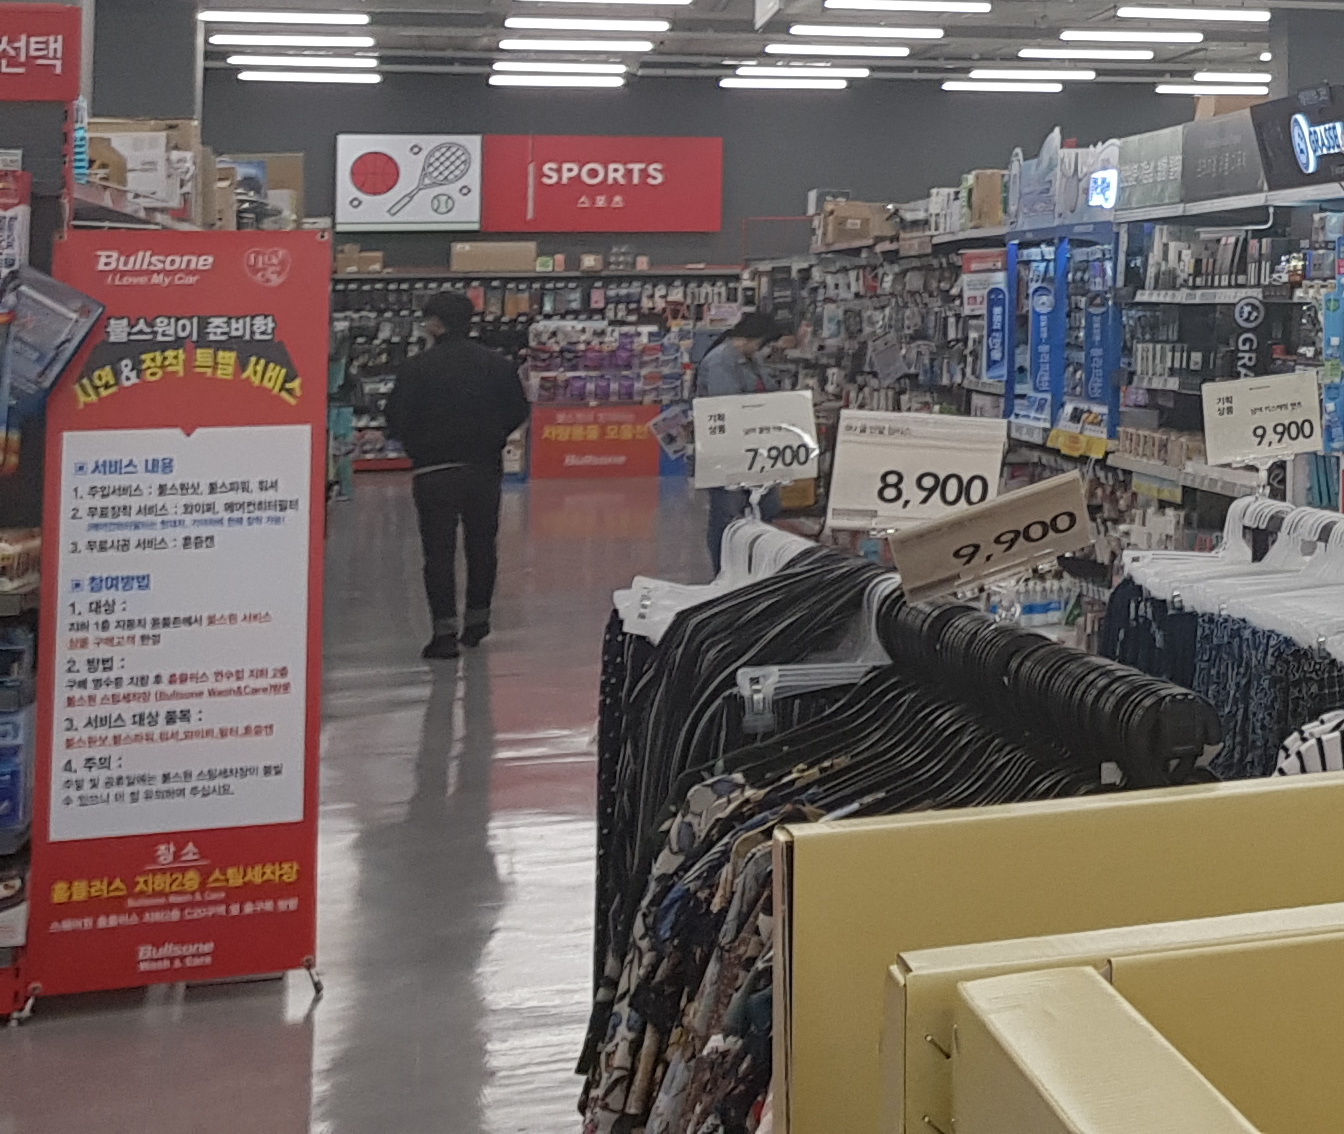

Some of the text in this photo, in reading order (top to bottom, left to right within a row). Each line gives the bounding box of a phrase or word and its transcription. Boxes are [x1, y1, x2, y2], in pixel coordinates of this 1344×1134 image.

[541, 161, 664, 186] SPORTS
[95, 250, 214, 271] Bullsone
[115, 273, 148, 285] Love
[151, 273, 172, 286] My
[105, 314, 275, 342] 불스원이 준비한
[120, 359, 140, 387] &
[140, 348, 185, 381] 장착
[194, 347, 237, 380] 특별
[242, 356, 303, 405] 서비스
[1253, 419, 1314, 447] 9,900
[90, 457, 174, 475] 서비스 내용
[744, 444, 809, 473] 7,900
[877, 469, 988, 509] 8,900
[952, 510, 1077, 566] 9,900
[69, 602, 82, 615] 1.
[83, 712, 126, 730] 서비스
